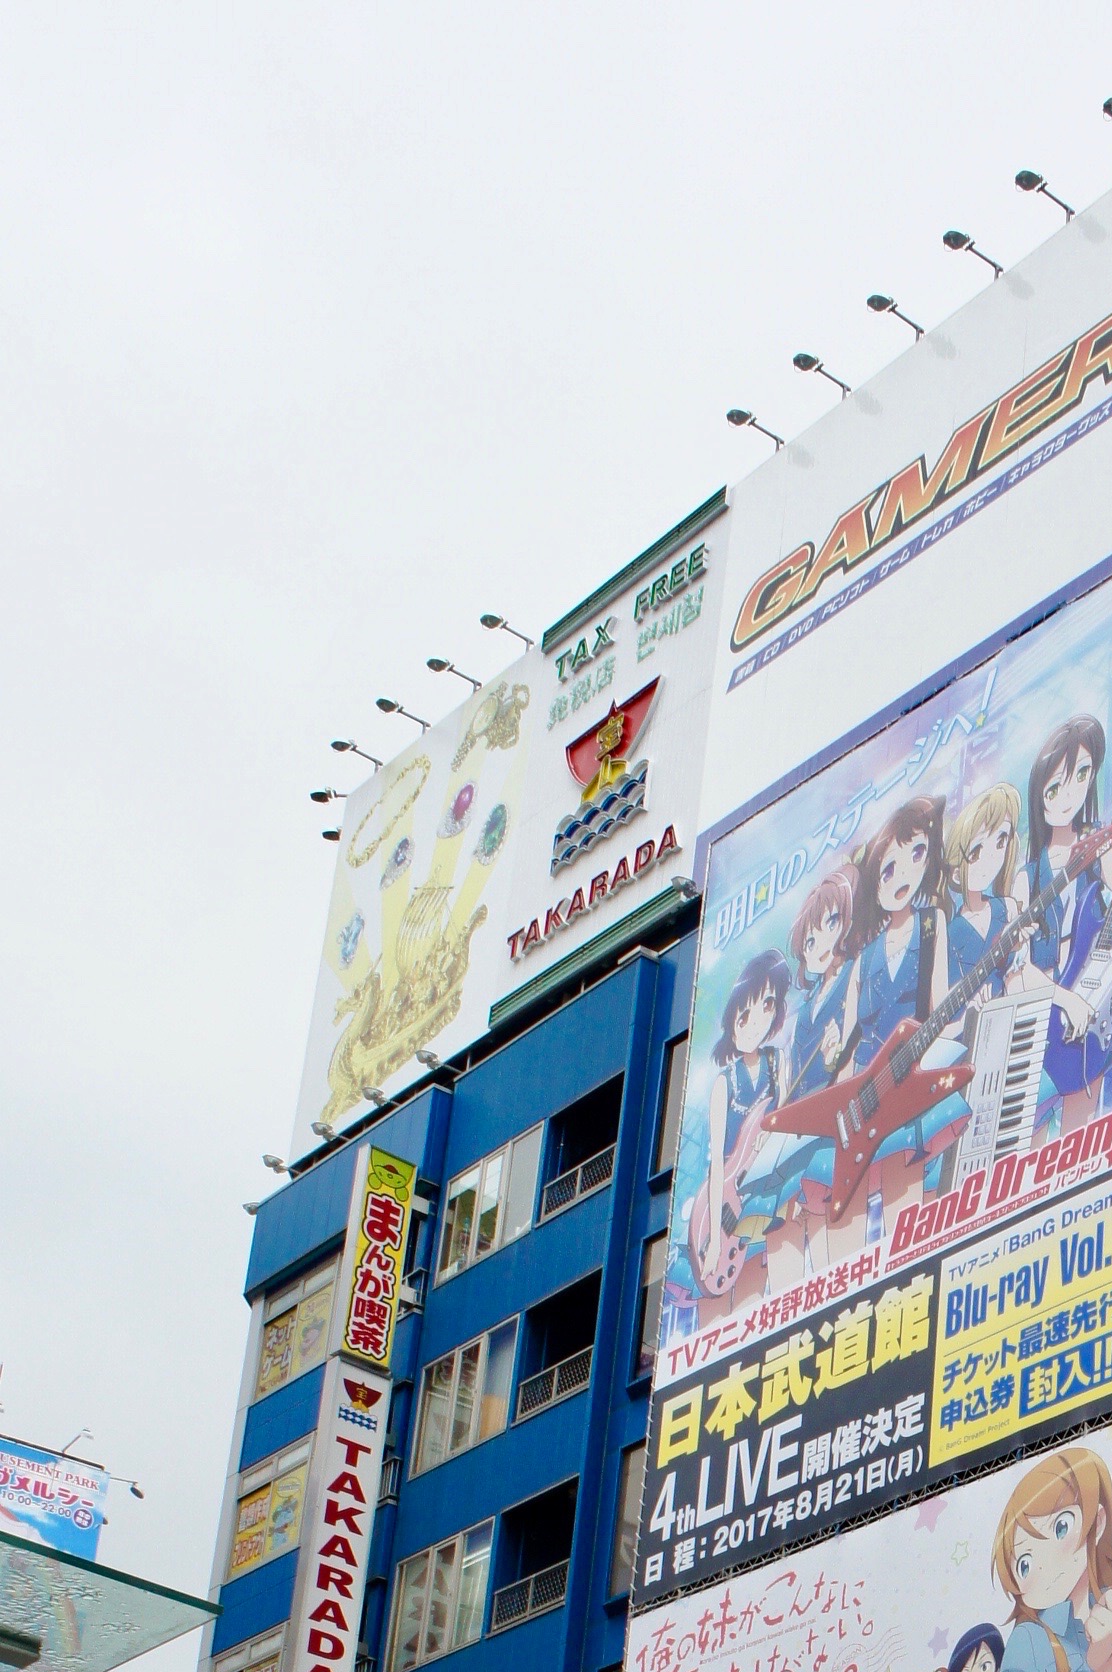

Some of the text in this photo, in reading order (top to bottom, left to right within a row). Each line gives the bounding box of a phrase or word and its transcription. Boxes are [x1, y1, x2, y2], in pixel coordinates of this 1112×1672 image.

[554, 542, 709, 683] TAX FREE
[763, 641, 780, 663] CD
[788, 616, 814, 643] DVD
[822, 578, 870, 619] PCソフト
[879, 548, 910, 578] ゲーム
[921, 516, 955, 548] トレカ
[964, 487, 997, 517] ホビー
[507, 824, 682, 966] TAKARADA
[344, 1192, 403, 1360] まんが喫茶
[889, 1169, 987, 1257] BanG
[262, 1344, 292, 1379] ゲーム
[667, 1246, 880, 1376] TVアニメ好評放送中!
[944, 1255, 1049, 1340] Blu-ray
[657, 1272, 935, 1469] 日本武道館
[940, 1375, 1016, 1433] 申込券
[65, 1472, 100, 1491] PARK
